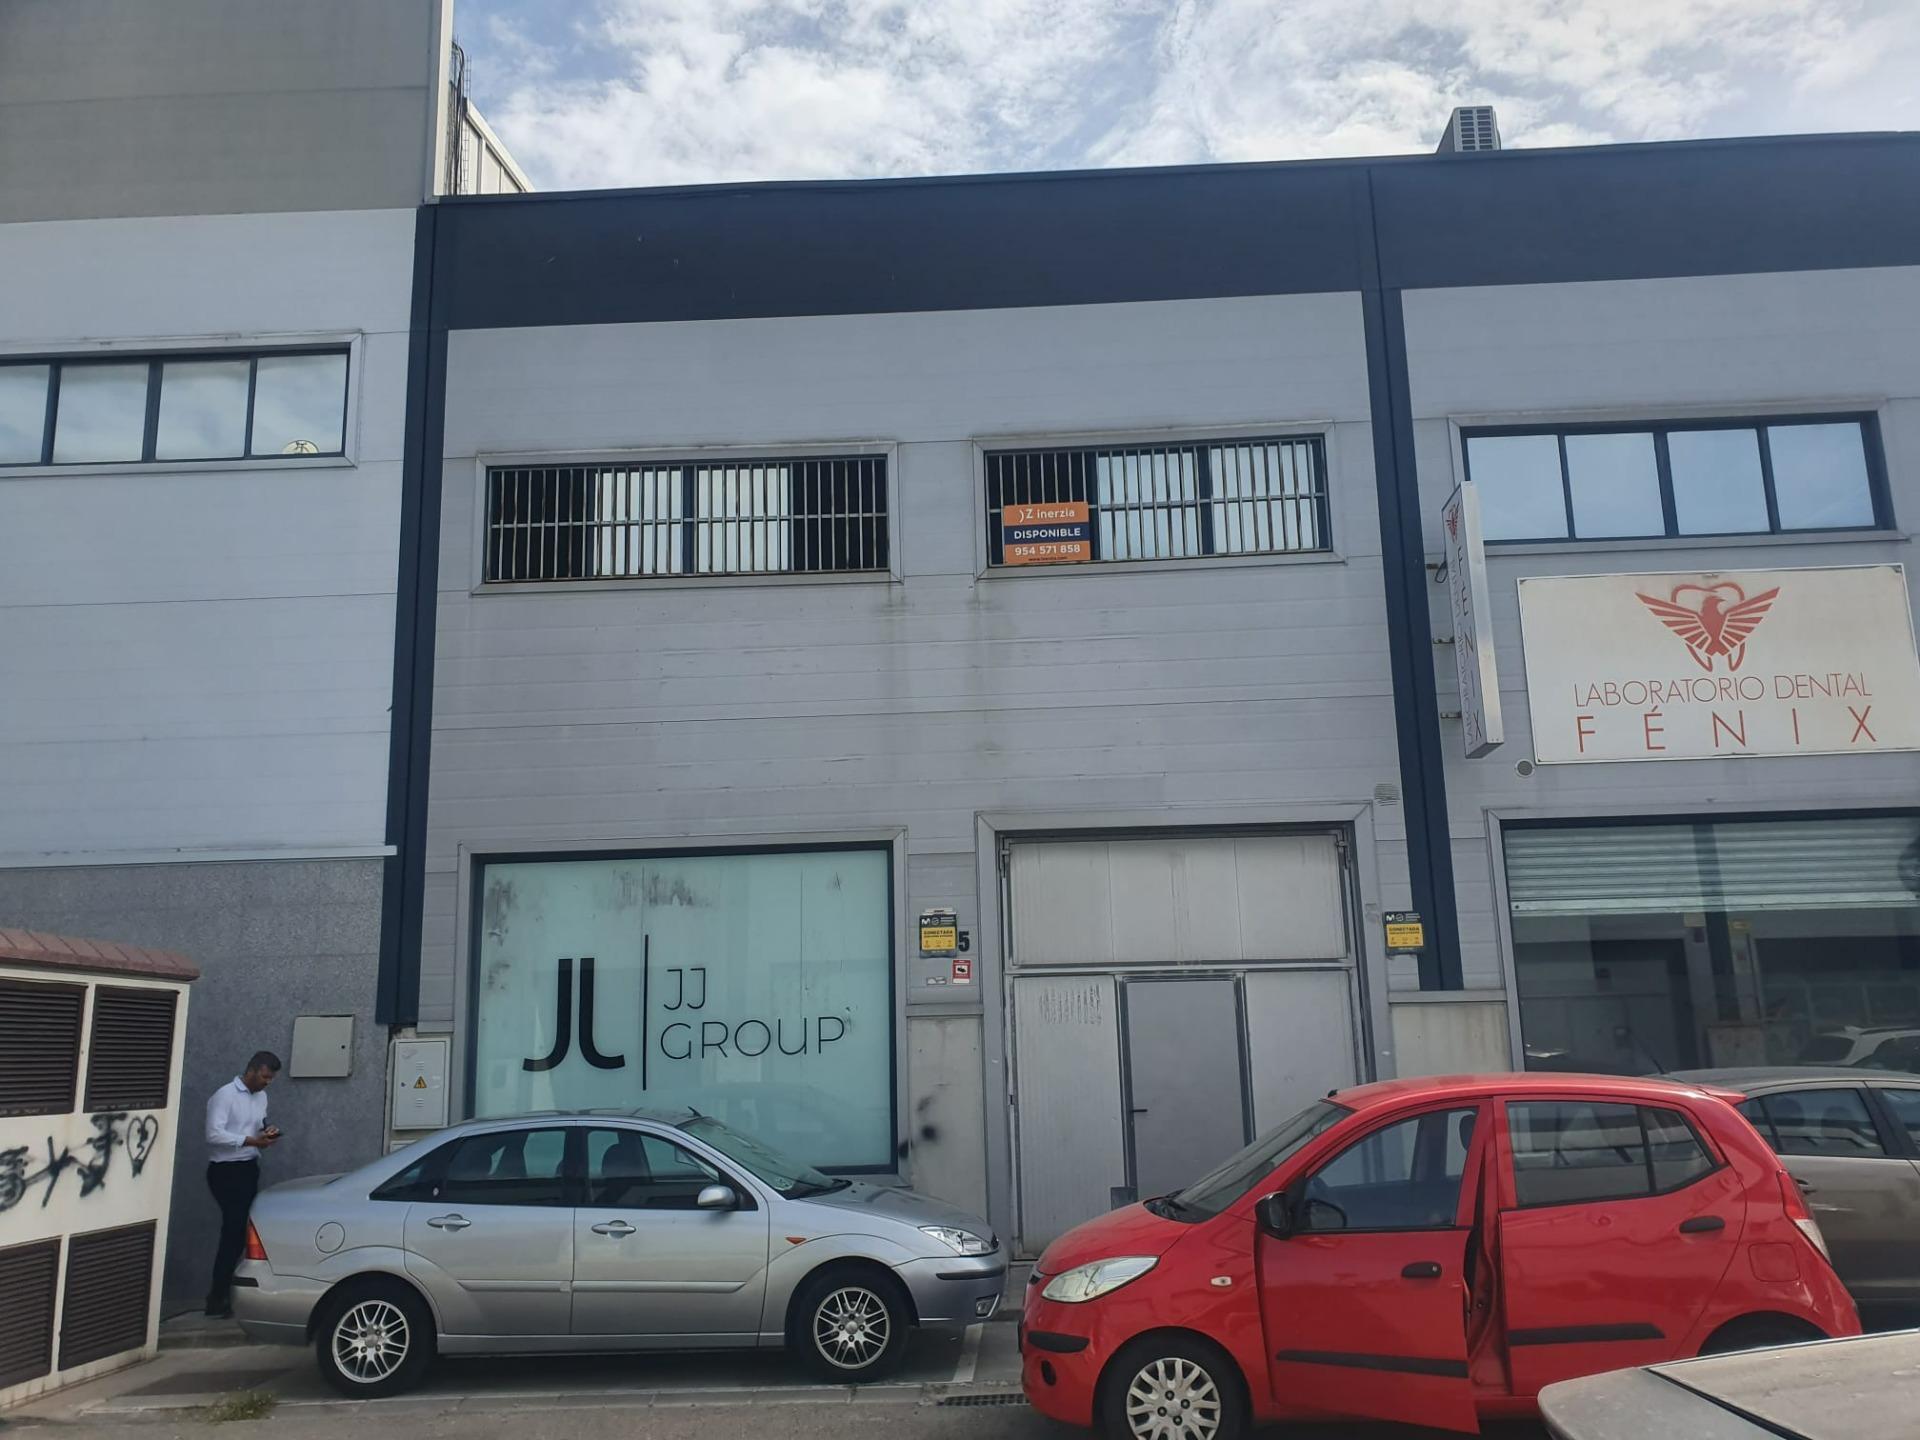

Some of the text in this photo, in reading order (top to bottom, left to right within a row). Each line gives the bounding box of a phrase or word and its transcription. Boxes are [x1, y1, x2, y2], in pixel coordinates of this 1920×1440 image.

[1037, 508, 1075, 519] inerzia
[1014, 527, 1081, 539] DISPONIBLE
[1014, 544, 1081, 556] 954 571 858
[1574, 672, 1873, 708] LABORATORIO DENTAL
[1576, 705, 1877, 753] FÉNIX
[958, 930, 970, 952] 5
[663, 967, 707, 1011] JJ
[660, 1015, 845, 1060] GROUP
